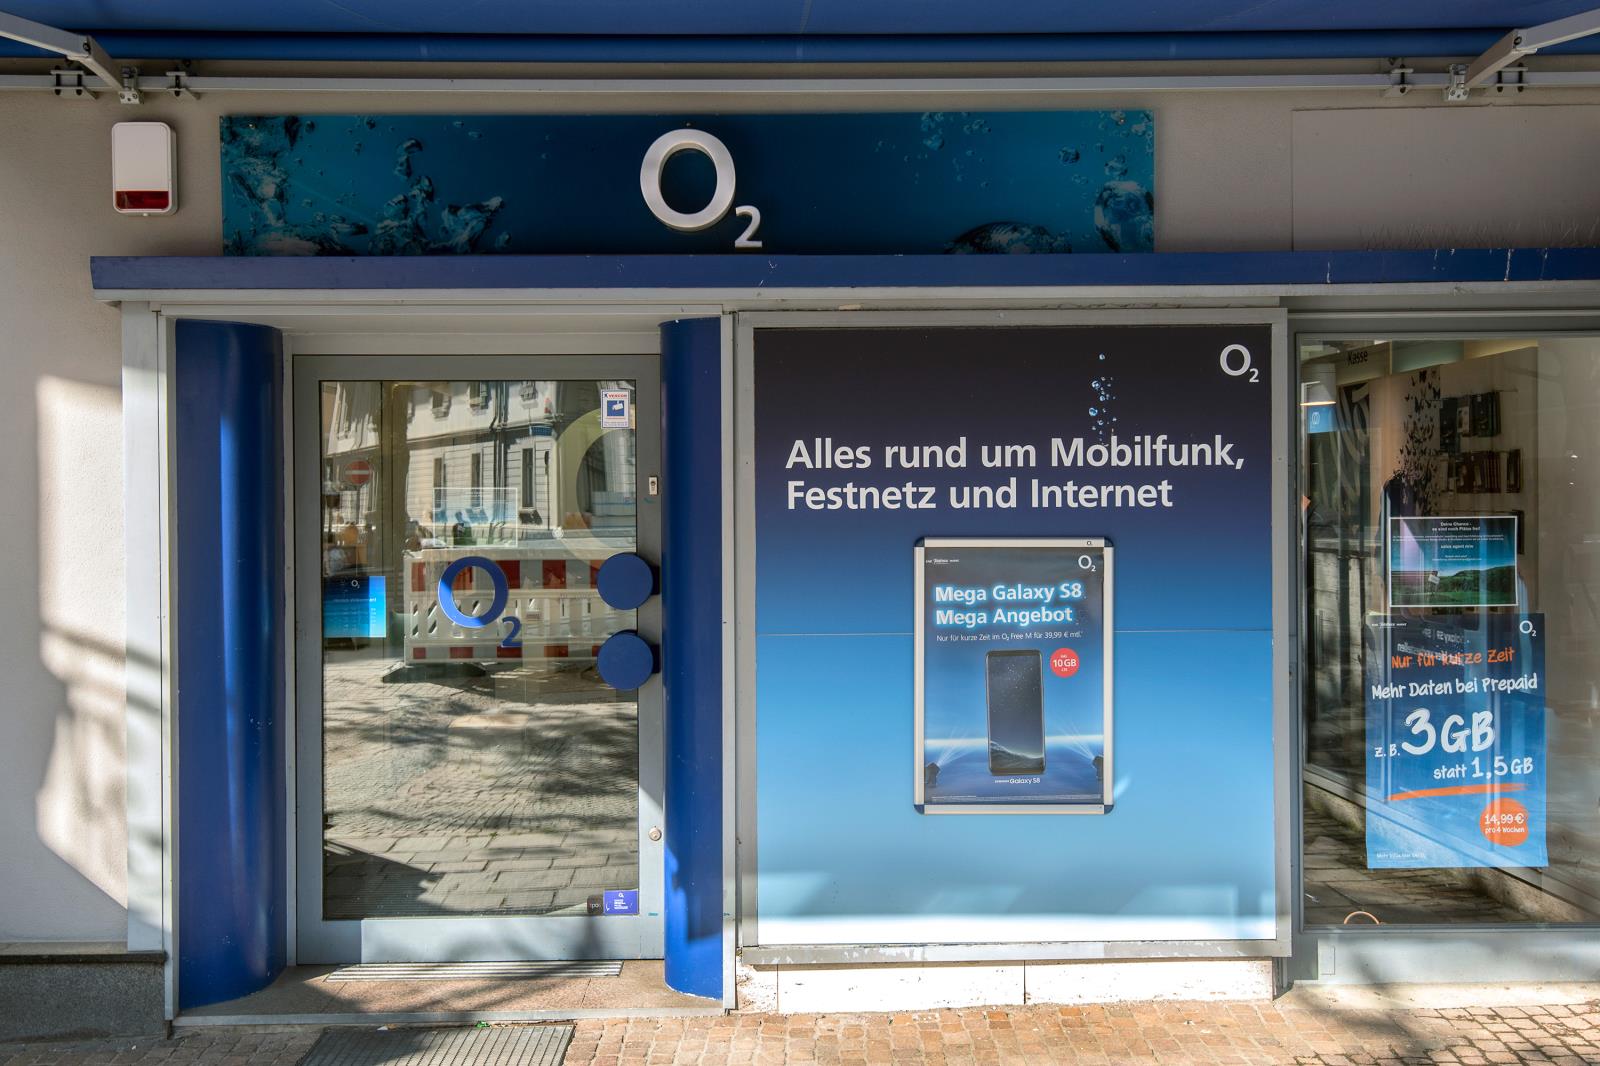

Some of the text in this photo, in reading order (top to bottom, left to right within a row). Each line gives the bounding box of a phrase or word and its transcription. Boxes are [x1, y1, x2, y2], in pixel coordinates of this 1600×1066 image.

[1219, 343, 1260, 383] O2
[1346, 350, 1369, 364] Kasse
[785, 434, 1245, 470] Alles rund um Mobilfunk,
[787, 476, 1174, 510] Festnetz und Internet
[1078, 554, 1096, 572] O2
[935, 583, 1083, 605] Mega Galaxy S8
[936, 606, 1073, 629] Mega Angebot
[1519, 620, 1537, 637] O2
[936, 634, 948, 642] Nur
[978, 633, 990, 641] Zeit
[1010, 632, 1024, 640] Free
[1033, 632, 1044, 640] für
[1044, 631, 1062, 639] 39,99
[1063, 631, 1069, 639] €
[1391, 646, 1515, 669] Nur für kurze Zeit
[1371, 673, 1538, 700] Mehr Daten bei Prepaid
[1009, 777, 1032, 785] Galaxy
[1433, 763, 1467, 779] statt
